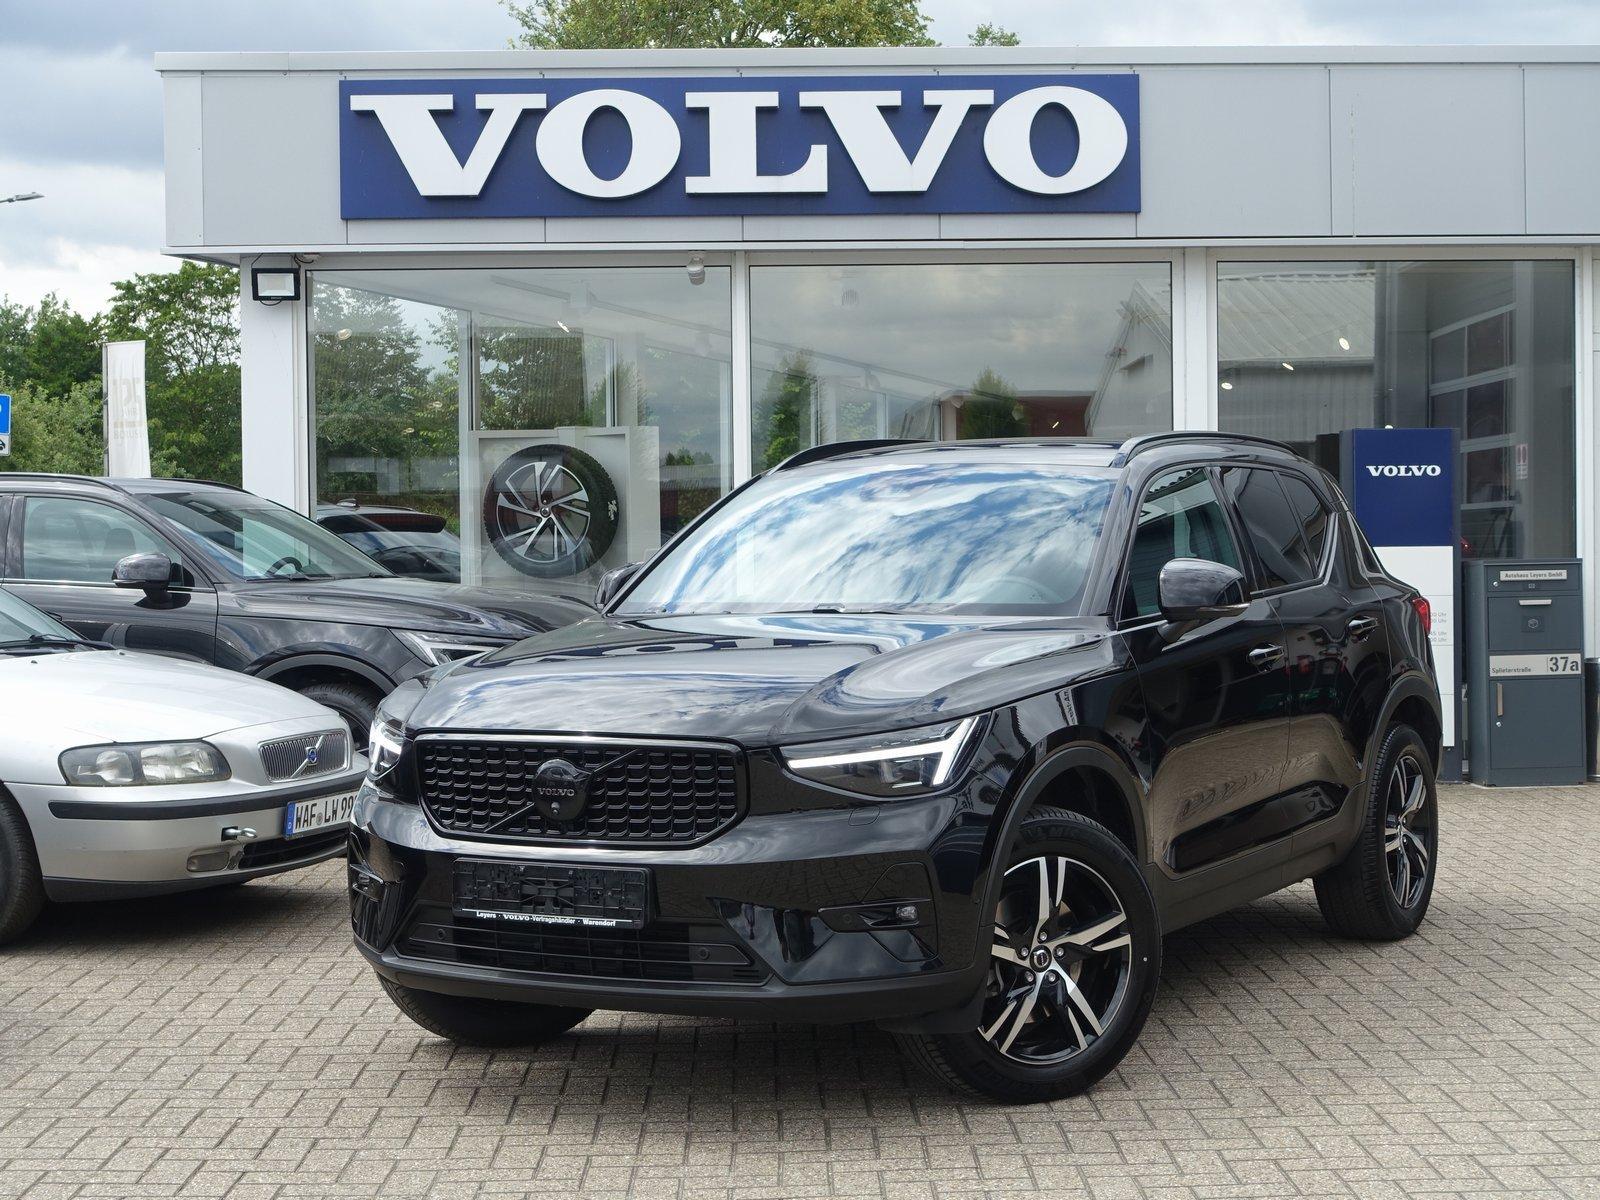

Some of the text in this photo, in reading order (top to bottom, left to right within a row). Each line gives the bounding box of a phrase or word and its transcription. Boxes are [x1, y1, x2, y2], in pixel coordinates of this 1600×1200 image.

[350, 85, 1128, 198] VOLVO
[1366, 465, 1441, 477] VOLVO
[1505, 571, 1529, 579] Autohaus
[1549, 656, 1579, 673] 37a
[538, 788, 575, 797] VOLVO
[341, 795, 357, 819] 99
[476, 911, 497, 919] Leyers
[582, 919, 616, 927] Warendorf
